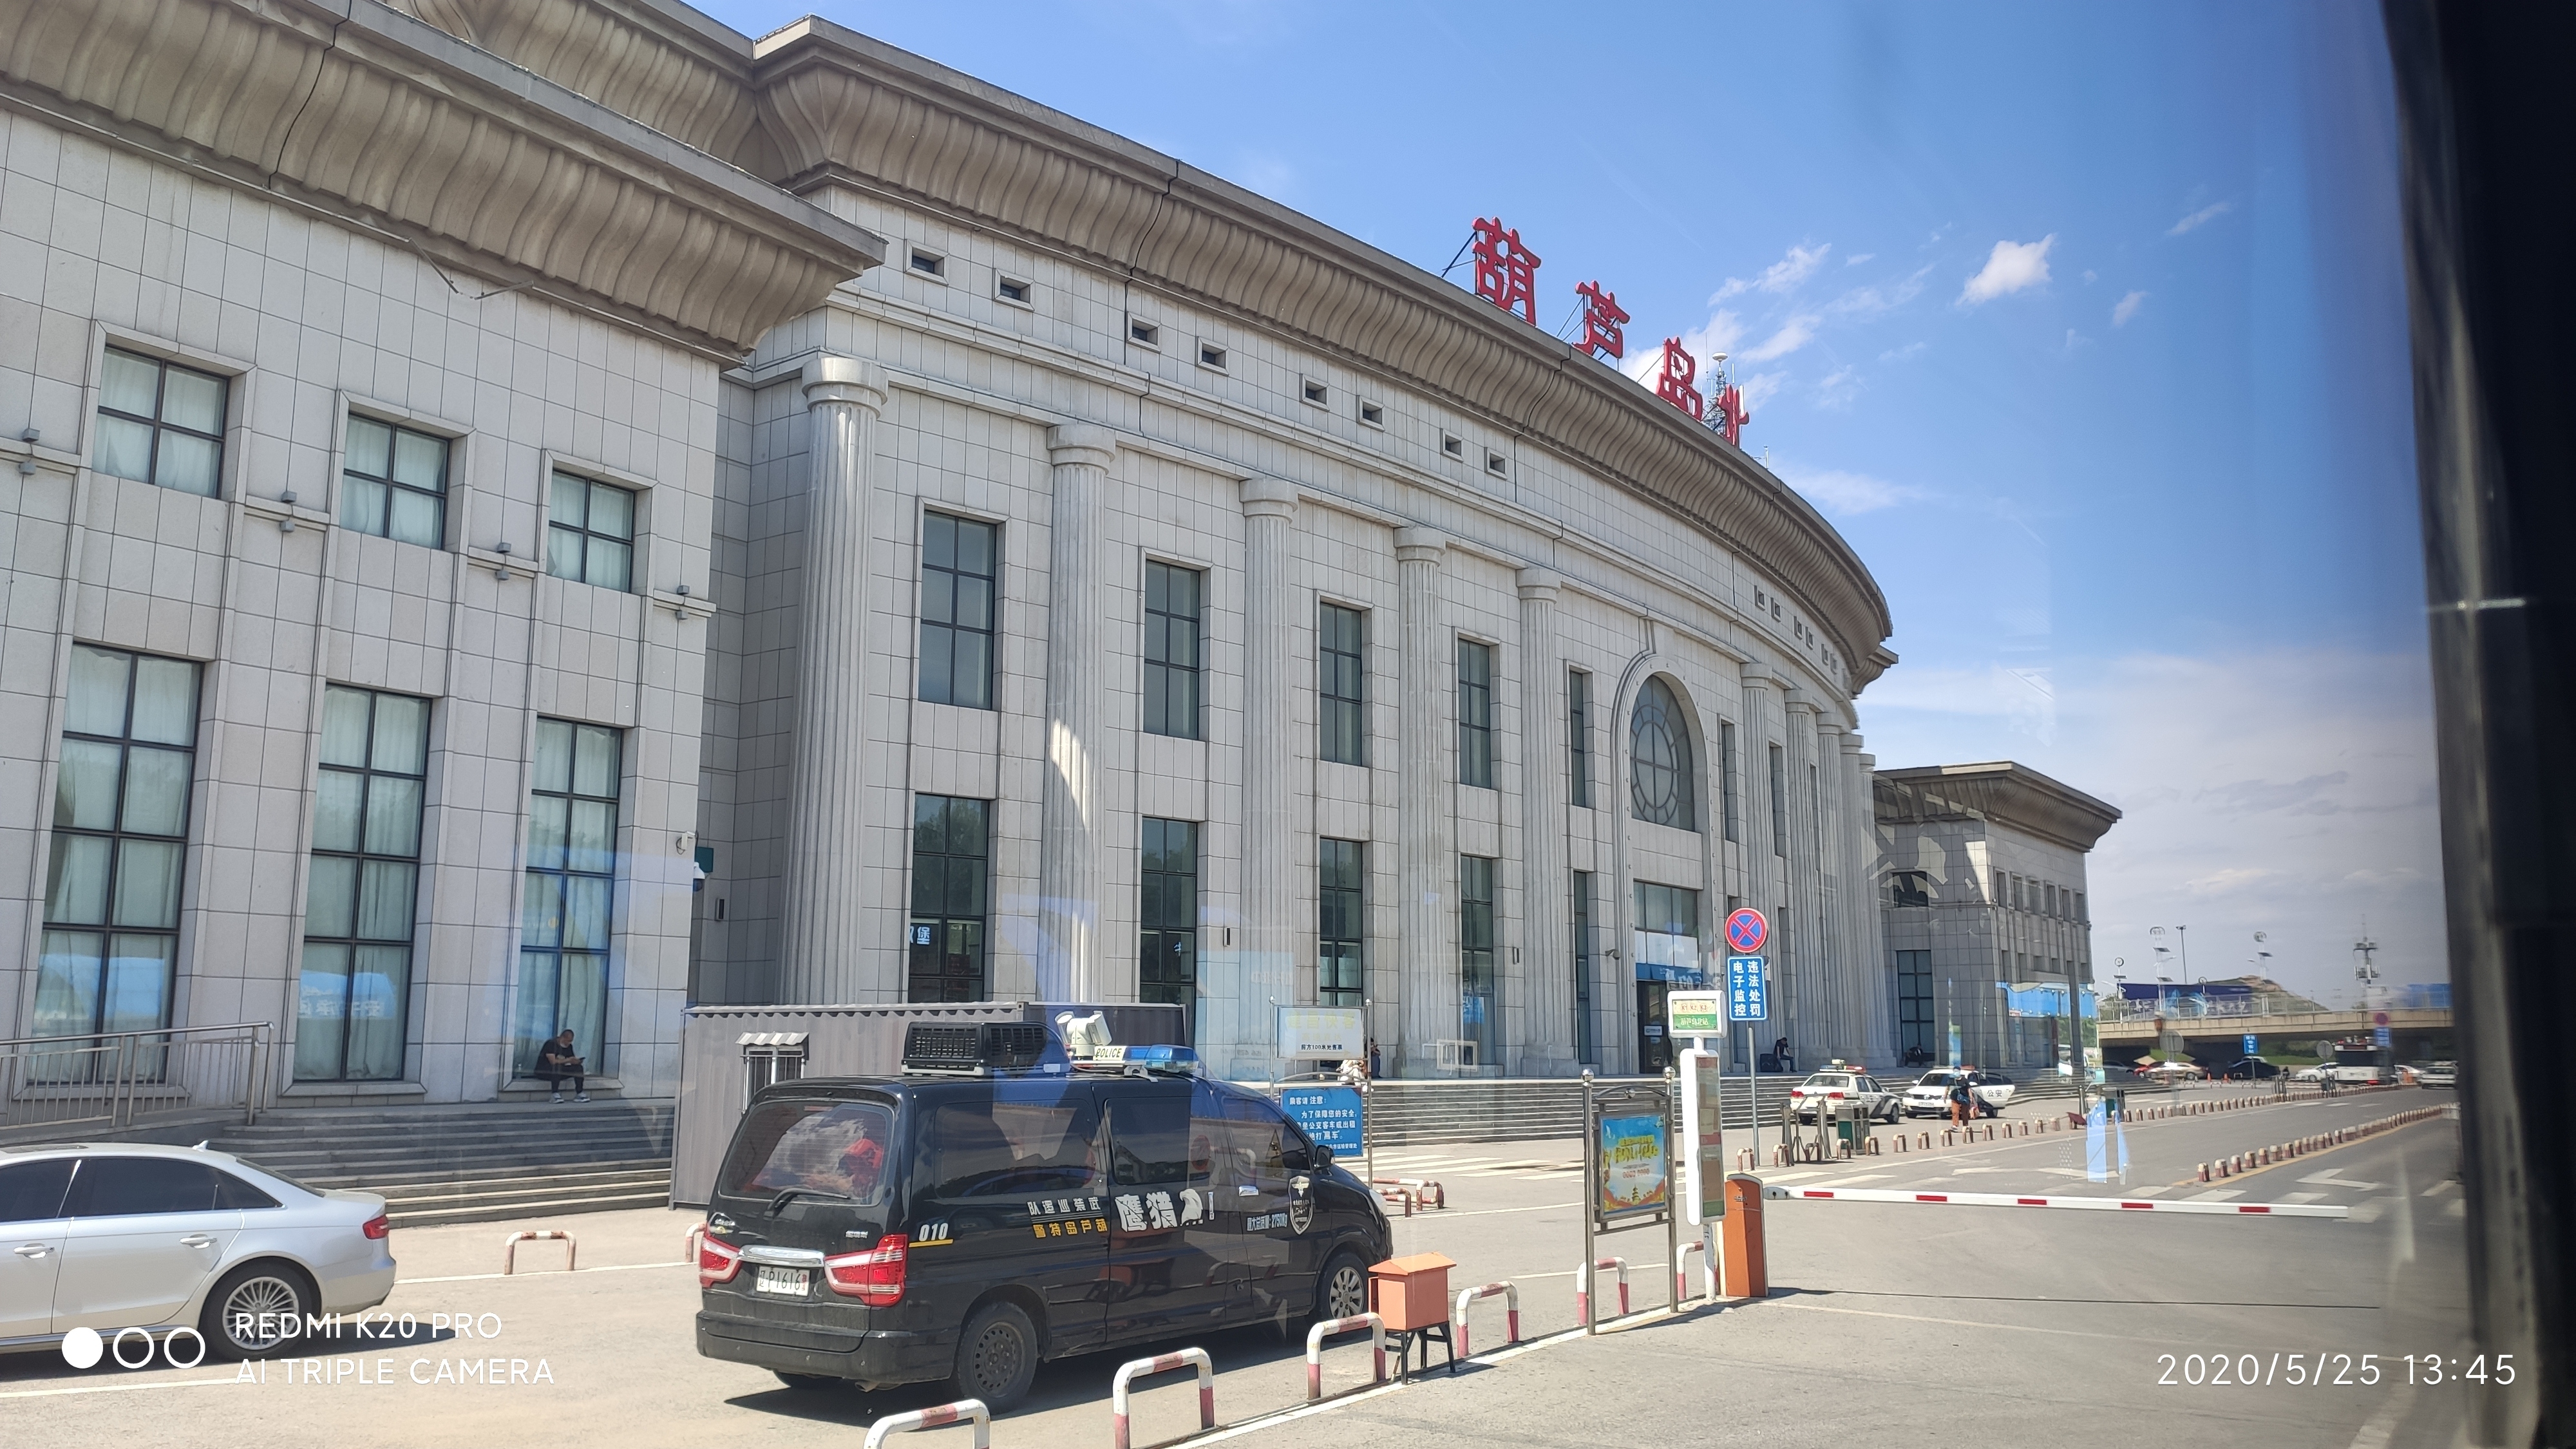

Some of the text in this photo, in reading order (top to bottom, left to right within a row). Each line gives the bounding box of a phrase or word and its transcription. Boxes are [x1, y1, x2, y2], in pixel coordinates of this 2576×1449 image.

[1733, 961, 1747, 1016] 电子监控
[1747, 960, 1761, 1017] 违法处罚
[1095, 1048, 1122, 1058] POLICE
[1987, 1089, 2002, 1097] 公安
[918, 1222, 949, 1242] 010
